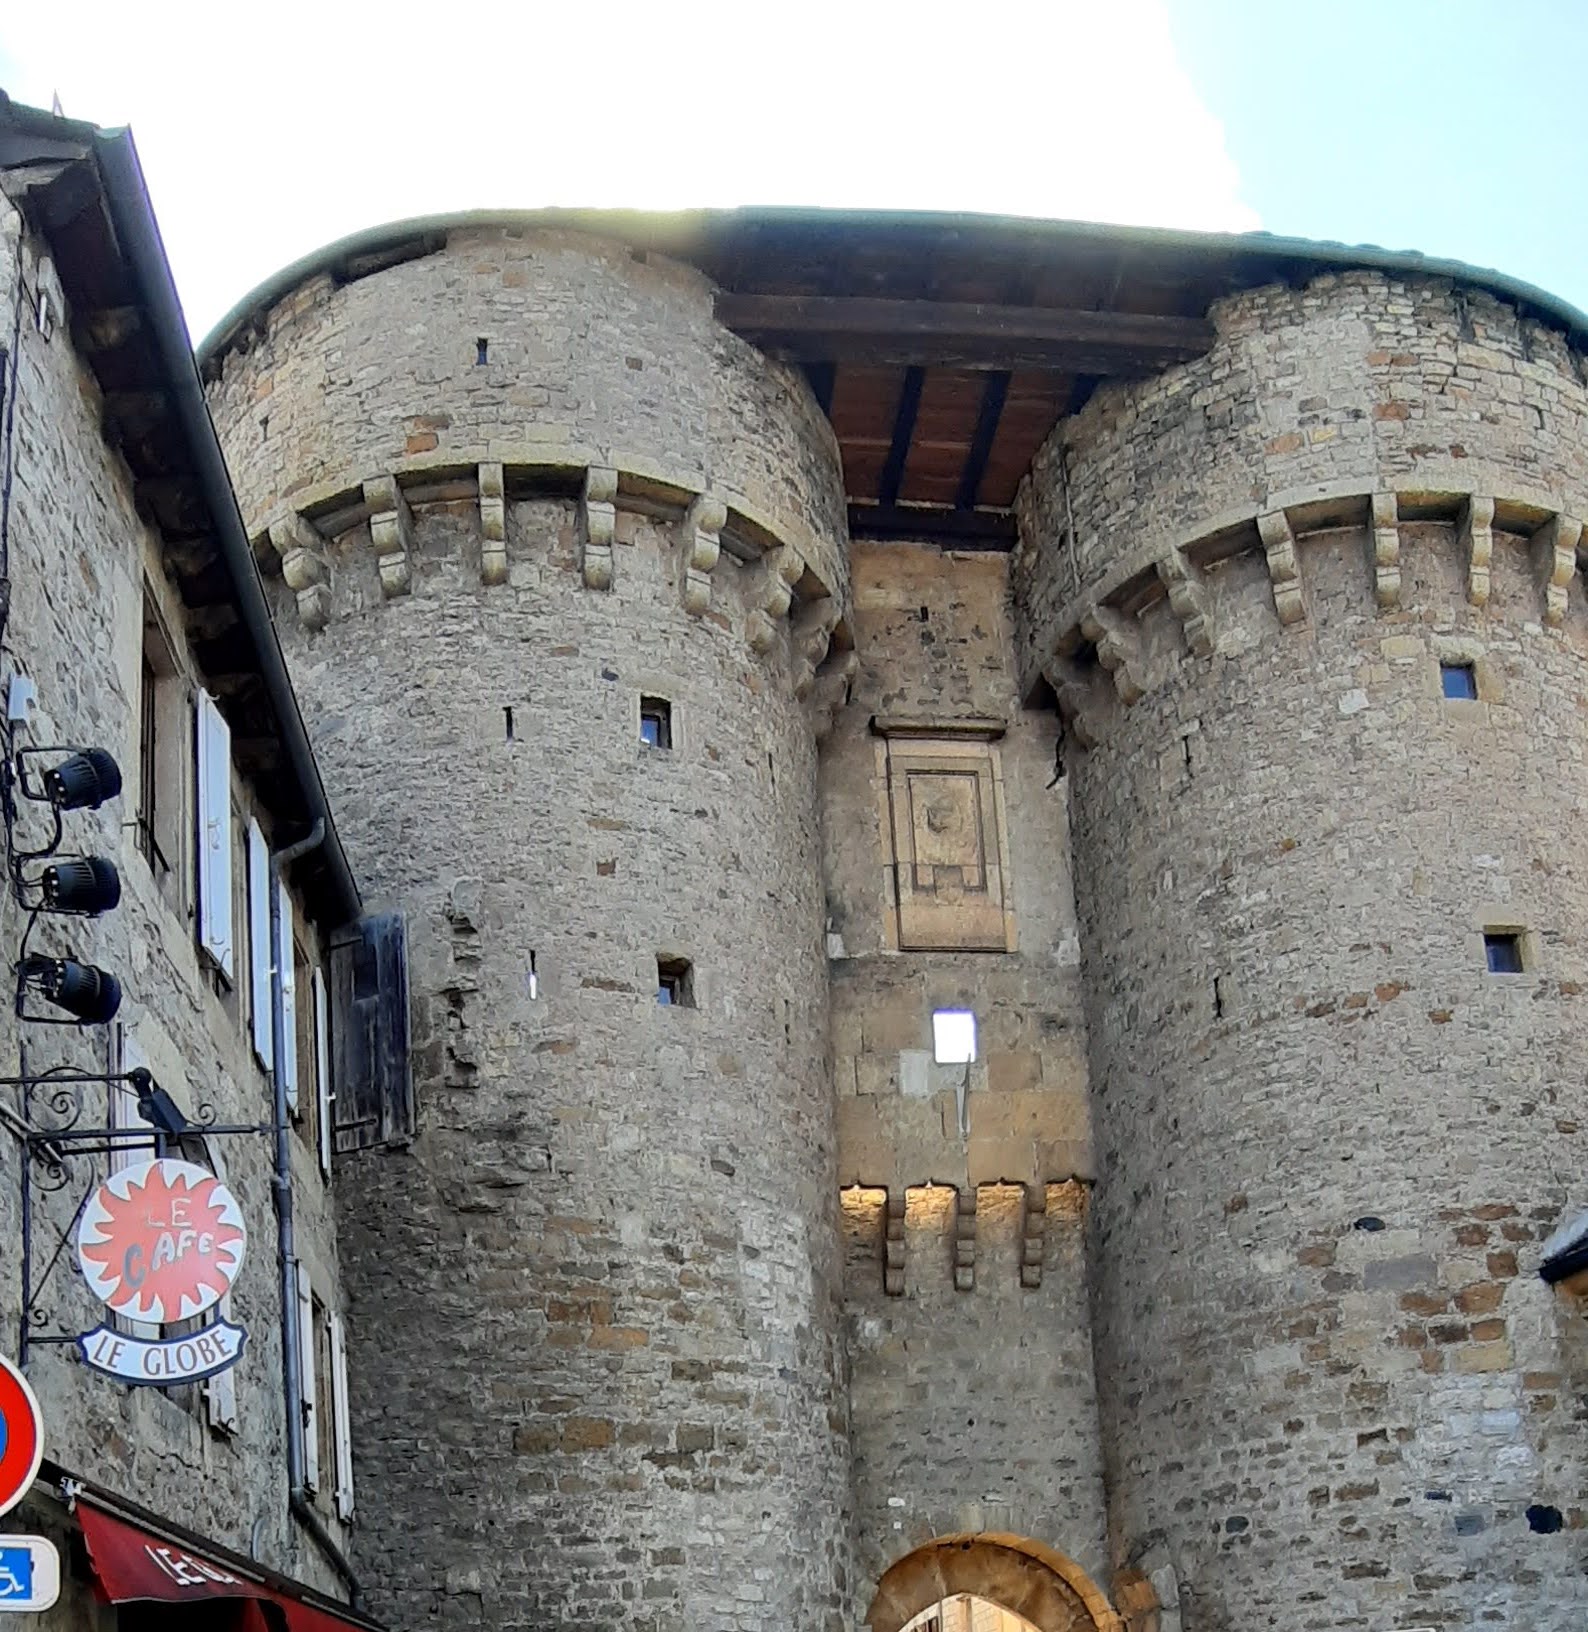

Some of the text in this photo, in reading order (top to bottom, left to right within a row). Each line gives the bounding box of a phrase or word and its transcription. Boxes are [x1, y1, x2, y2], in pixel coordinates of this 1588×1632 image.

[146, 1198, 192, 1228] LE
[93, 1329, 233, 1377] LE GLOBE
